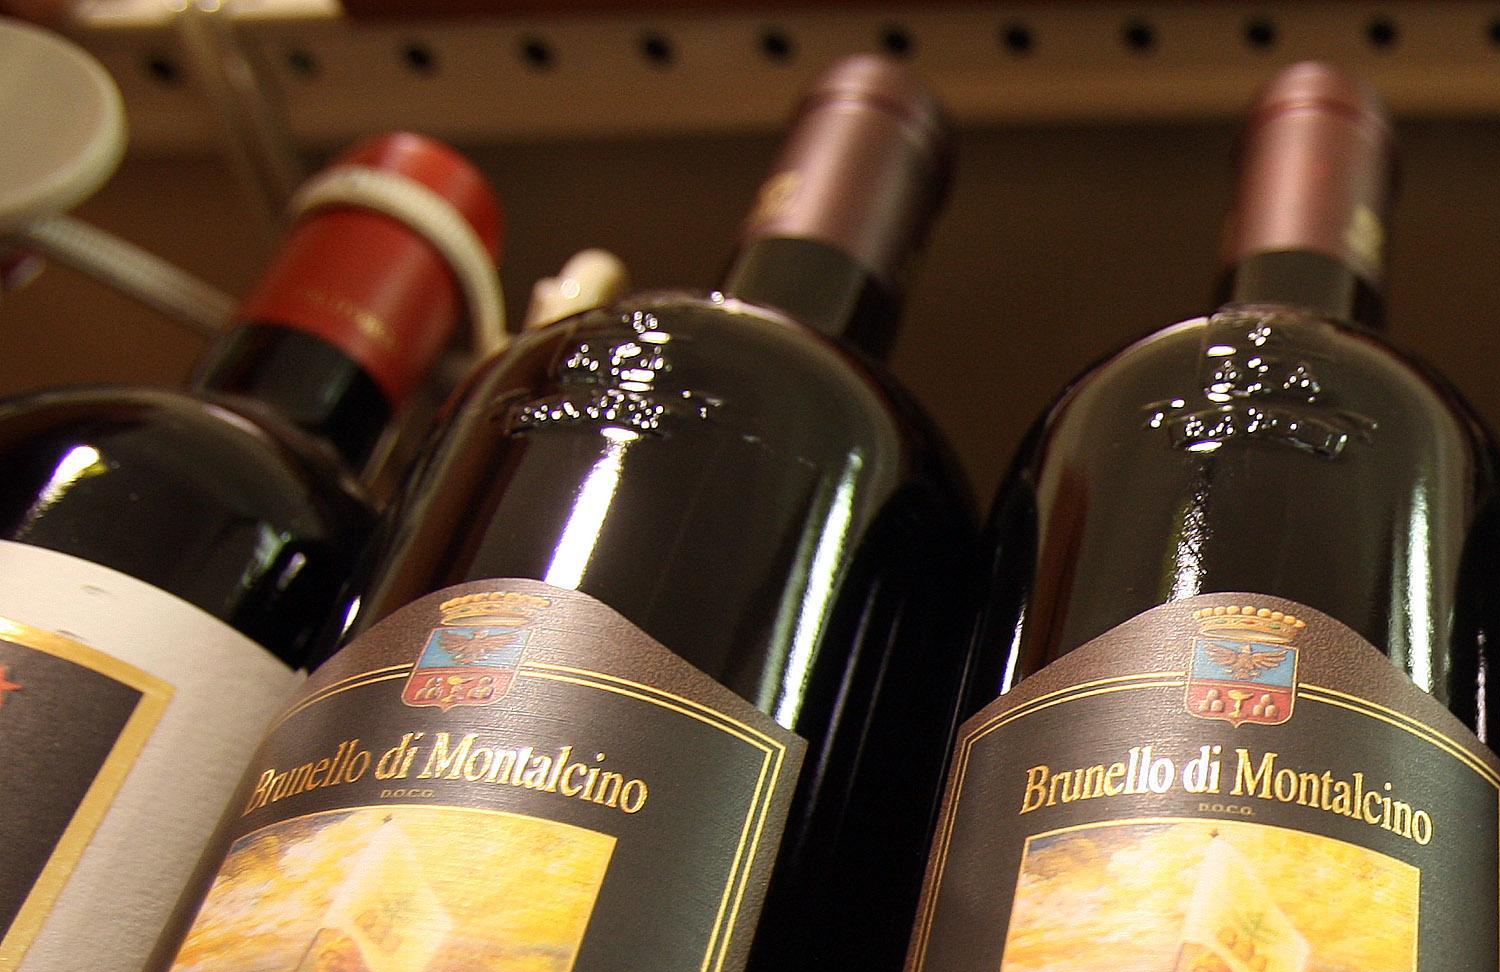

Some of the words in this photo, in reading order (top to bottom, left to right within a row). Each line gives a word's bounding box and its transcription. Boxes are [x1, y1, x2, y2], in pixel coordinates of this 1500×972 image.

[243, 738, 372, 818] Brunello
[375, 732, 423, 780] di
[417, 731, 650, 814] Montalcino
[1018, 746, 1175, 816] Brunello
[1182, 745, 1221, 794] di
[1231, 748, 1433, 846] Montalcino
